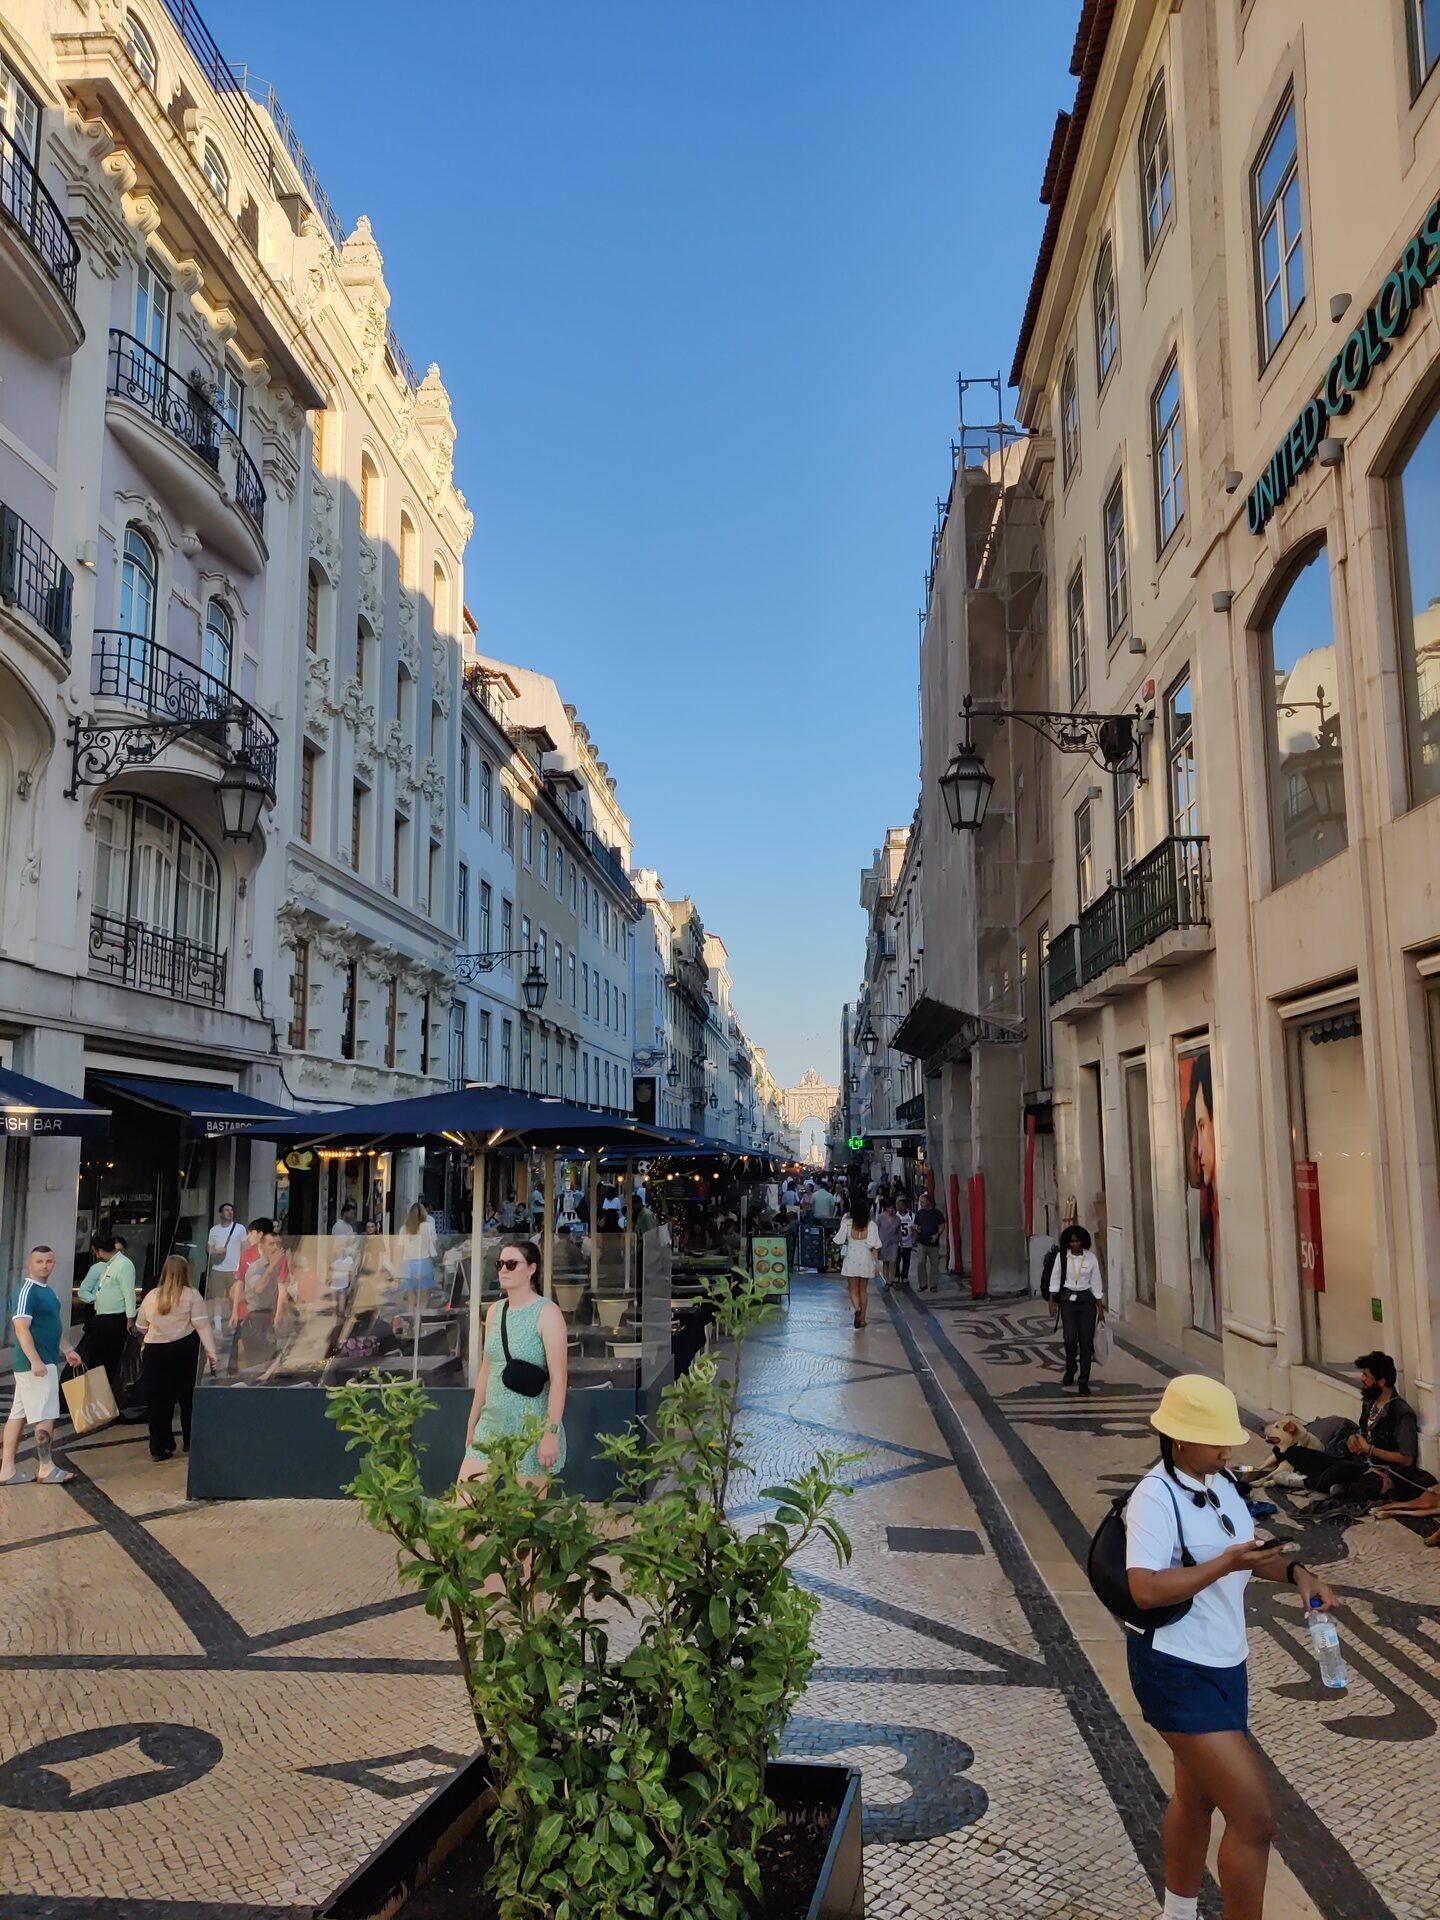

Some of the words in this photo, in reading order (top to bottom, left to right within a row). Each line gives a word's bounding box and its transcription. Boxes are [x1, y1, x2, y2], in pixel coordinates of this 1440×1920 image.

[1246, 398, 1326, 535] UNITED
[1323, 201, 1440, 416] COLORS
[33, 1118, 62, 1131] BAR
